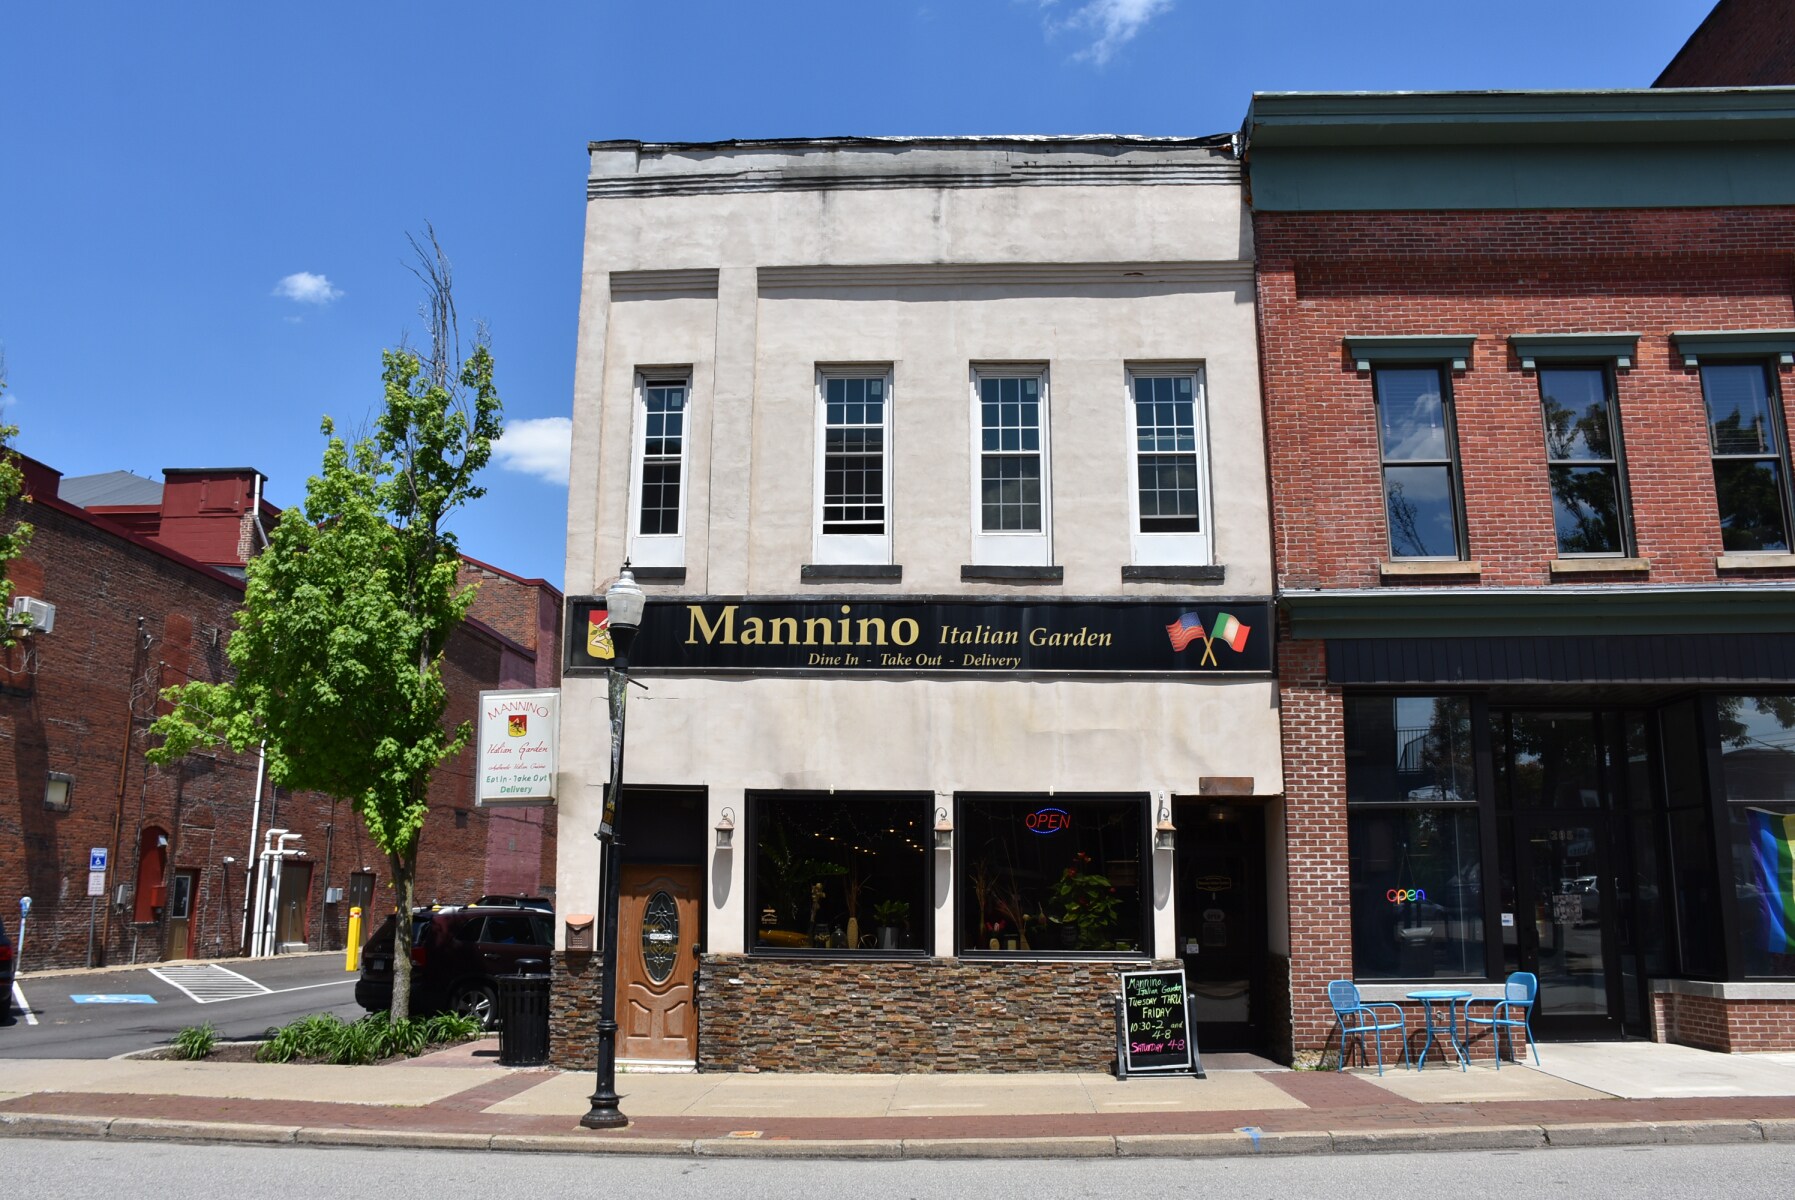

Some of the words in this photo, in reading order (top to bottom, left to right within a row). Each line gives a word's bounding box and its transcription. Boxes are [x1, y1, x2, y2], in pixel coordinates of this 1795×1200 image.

[685, 605, 920, 646] Mannino
[938, 624, 1019, 646] Italian
[1029, 625, 1113, 647] Garden
[807, 652, 841, 666] Dine
[844, 653, 859, 666] In
[880, 653, 912, 667] Take
[915, 653, 942, 667] Out
[962, 653, 1021, 670] Delivery
[487, 701, 549, 720] MANNINO
[487, 741, 512, 754] Italian
[519, 740, 548, 760] Garden
[533, 774, 547, 782] Out
[500, 785, 532, 793] Delivery
[1025, 813, 1071, 829] OPEN
[1386, 889, 1426, 905] open
[1161, 994, 1182, 1005] THRU
[1142, 1007, 1173, 1019] FRIDAY
[1170, 1021, 1184, 1029] and
[1152, 1030, 1171, 1039] 4-8
[1167, 1039, 1185, 1050] 4-8
